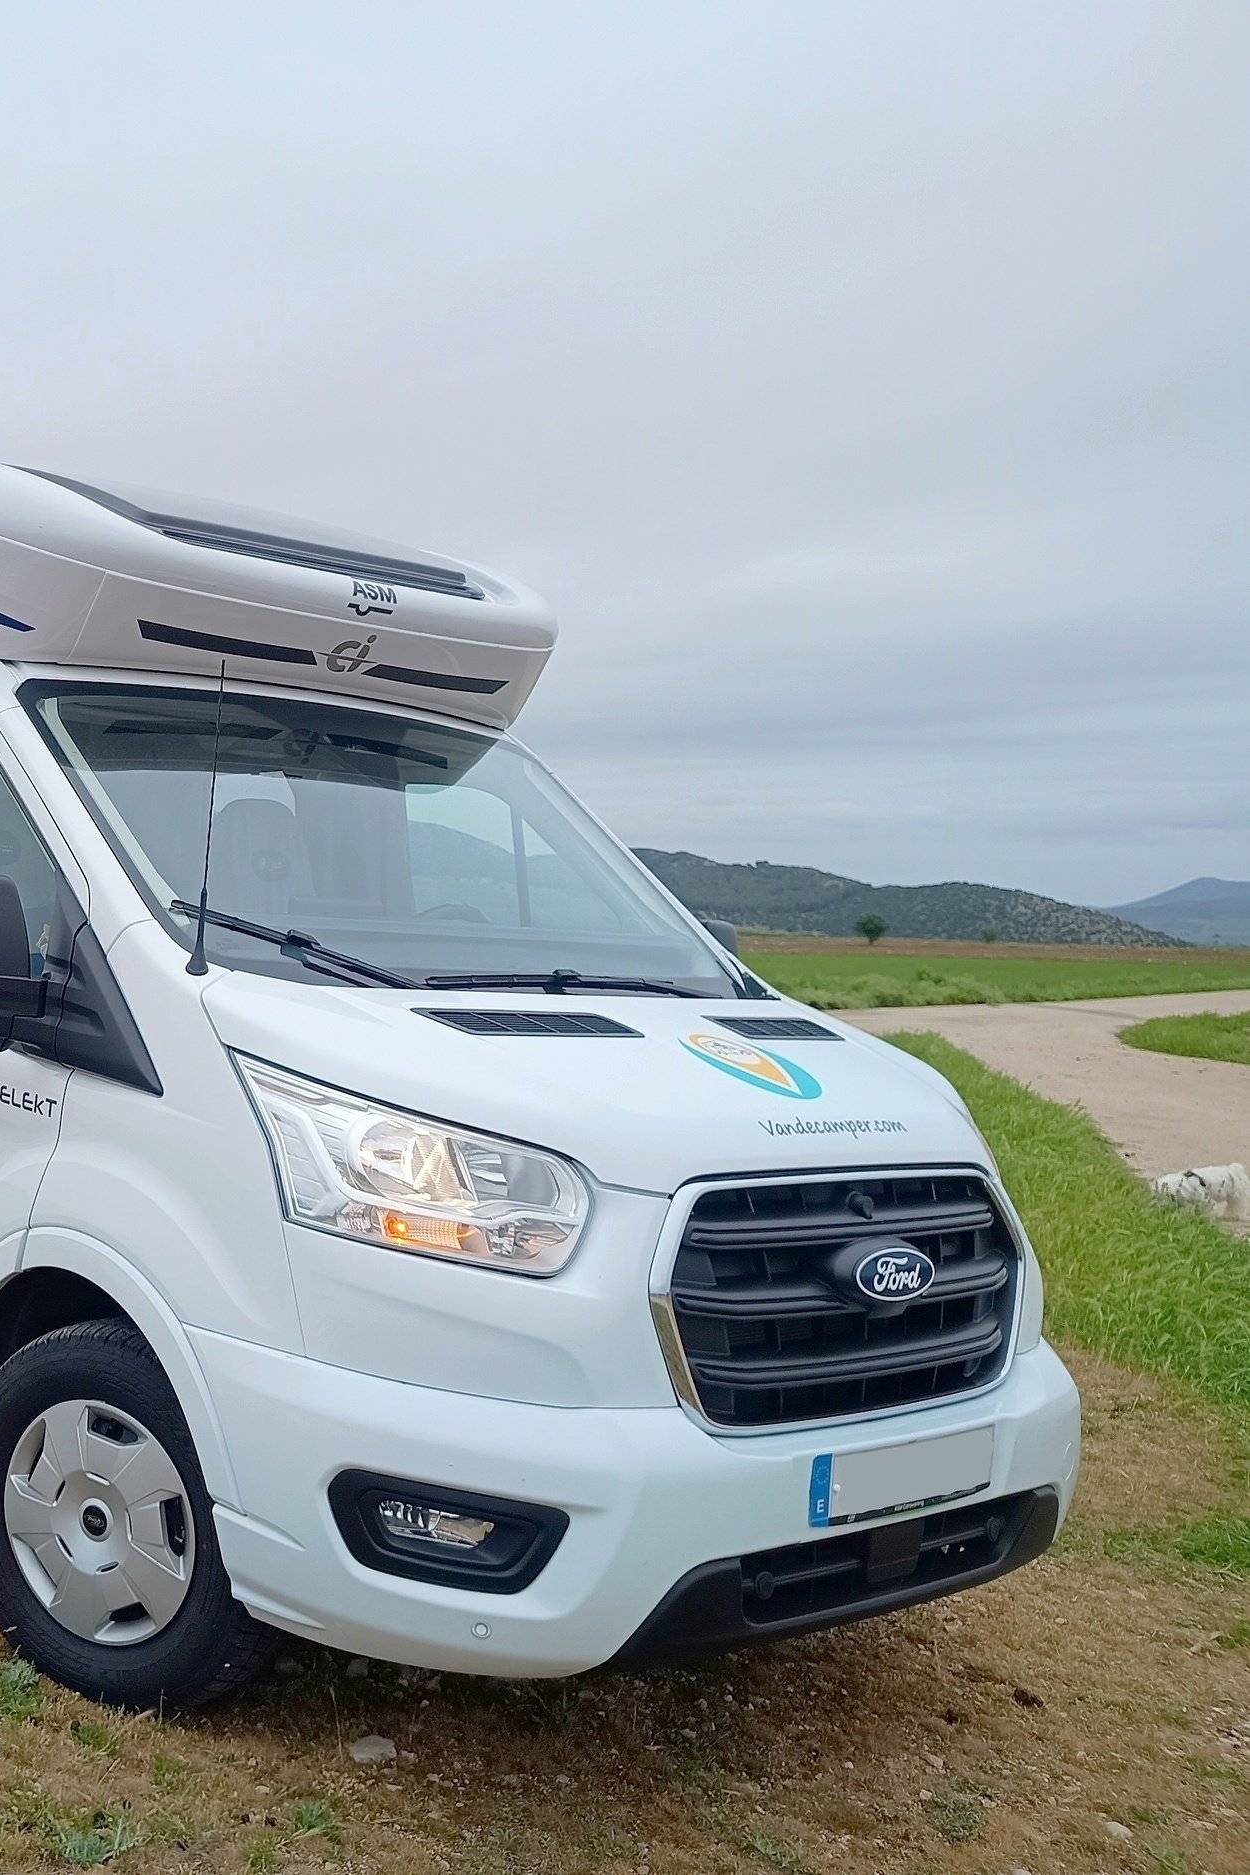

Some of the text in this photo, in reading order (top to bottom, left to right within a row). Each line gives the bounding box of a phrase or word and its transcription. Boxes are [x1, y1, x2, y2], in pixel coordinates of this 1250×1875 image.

[352, 580, 397, 604] ASM
[757, 1116, 909, 1139] Vandecamper.com
[873, 1256, 922, 1292] Ford
[816, 1499, 825, 1514] E
